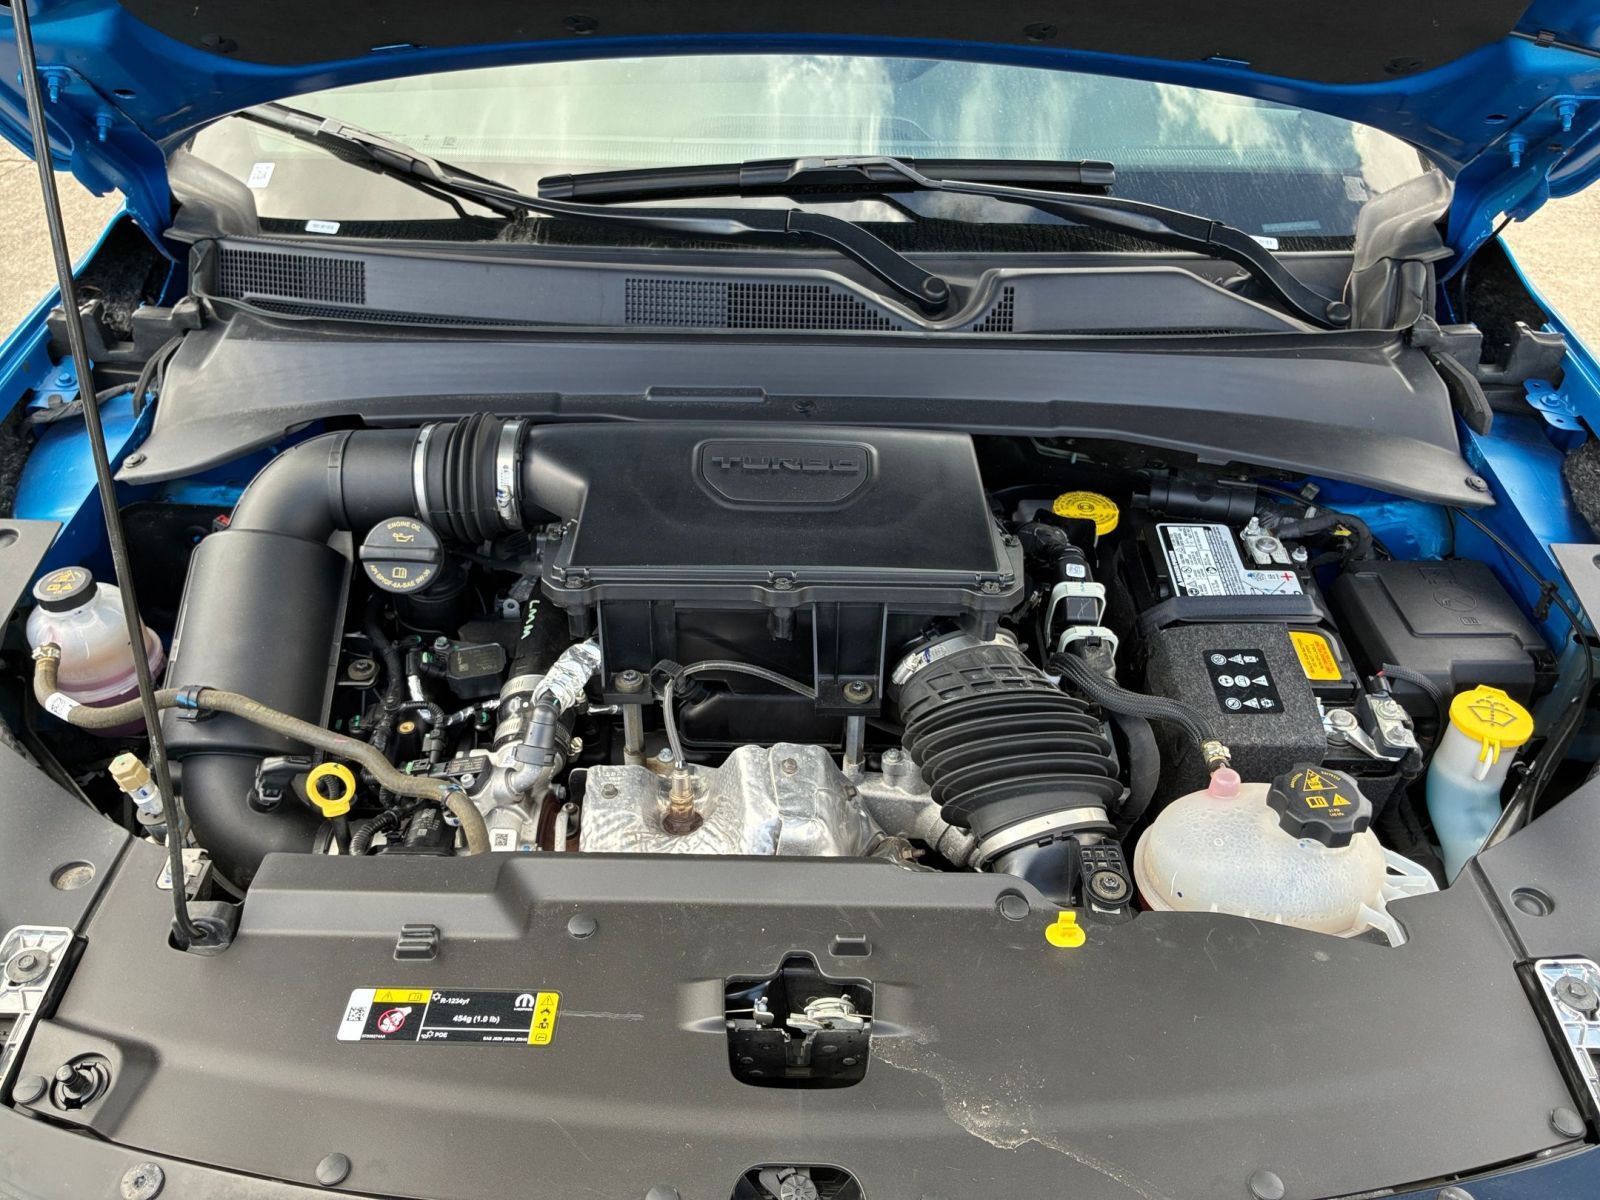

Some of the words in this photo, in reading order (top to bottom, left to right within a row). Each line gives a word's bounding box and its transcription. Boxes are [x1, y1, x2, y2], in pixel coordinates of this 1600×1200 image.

[711, 455, 861, 473] TURBO
[387, 521, 410, 530] ENGINE
[411, 523, 420, 532] OIL
[439, 997, 470, 1006] R-1234yf
[452, 1015, 472, 1024] 454g
[473, 1015, 489, 1024] (1.0
[489, 1015, 500, 1024] lb)
